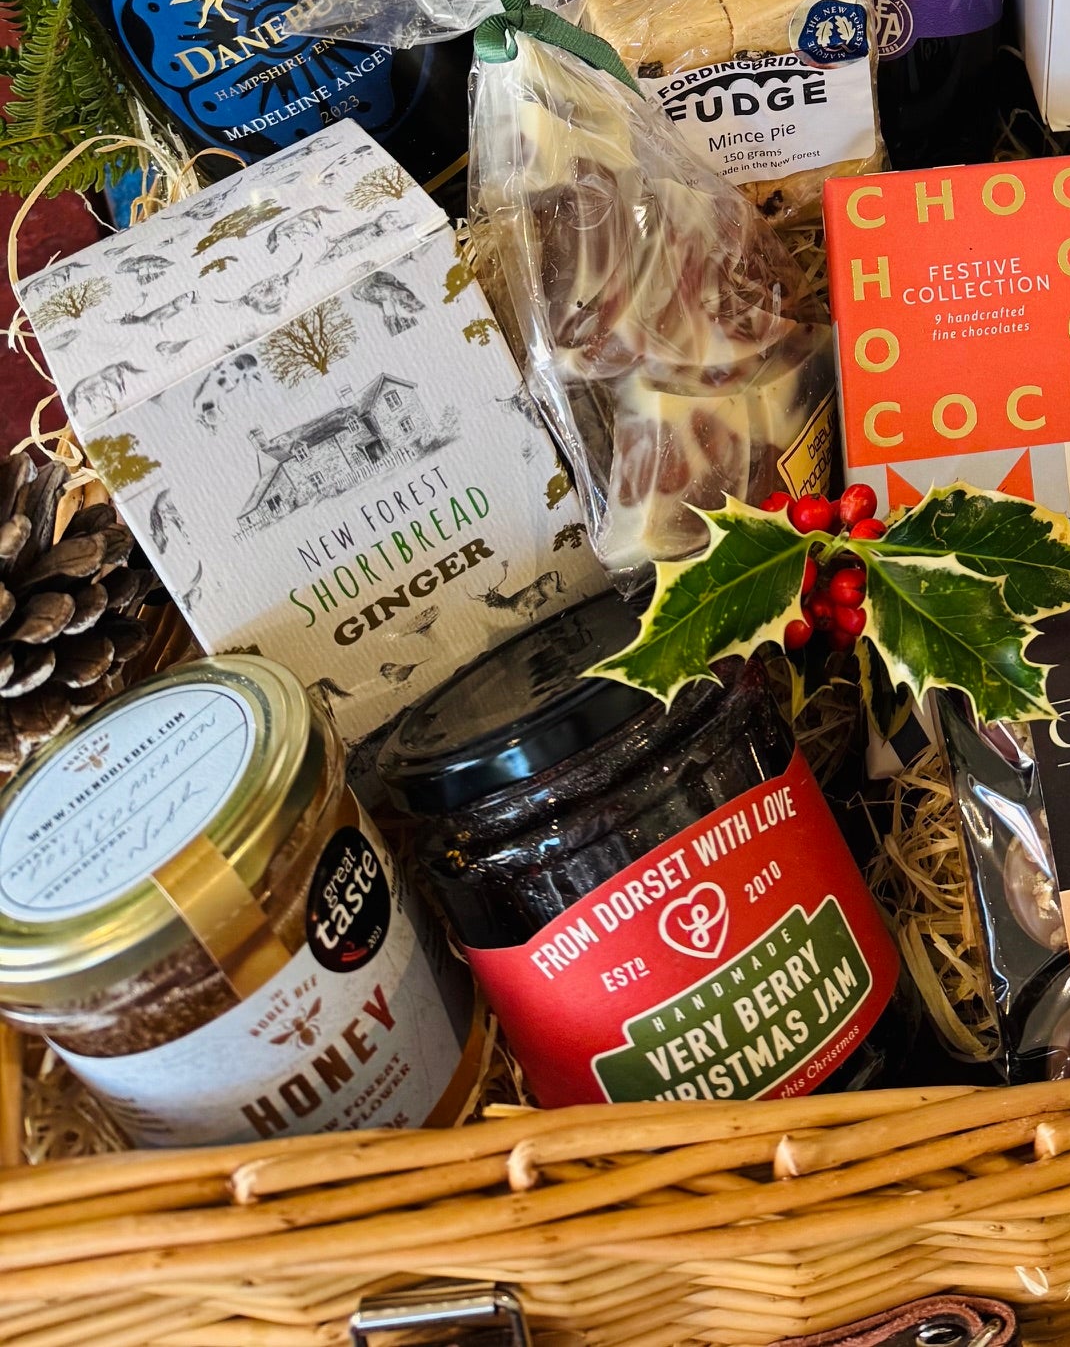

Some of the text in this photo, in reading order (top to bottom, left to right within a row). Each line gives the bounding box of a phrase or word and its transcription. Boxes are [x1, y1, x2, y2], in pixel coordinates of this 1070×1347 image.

[806, 5, 864, 50] THE NEW FOREST
[214, 52, 314, 102] HAMPSHIRE,
[664, 78, 828, 125] FUDGE
[223, 85, 333, 141] MADELEINE
[320, 95, 360, 124] 2023
[708, 123, 796, 152] Mince Pie
[723, 147, 782, 164] 150 grams
[752, 149, 820, 170] the New Forest
[902, 274, 1050, 305] COLLECTION
[928, 257, 1022, 282] FESTIVE
[931, 319, 1031, 343] fine chocolates
[946, 304, 1026, 325] handcrafted
[297, 465, 449, 573] NEW FOREST
[289, 486, 490, 629] SHORTBREAD
[333, 537, 495, 647] GINGER
[316, 850, 378, 950] taste
[323, 847, 357, 909] great
[530, 785, 797, 980] FROM DORSET WITH LOVE
[743, 859, 784, 904] 2010
[652, 927, 794, 1033] HANDMADE
[817, 956, 858, 1026] JAM
[645, 938, 823, 1082] VERY BERRY
[240, 983, 397, 1140] HONEY
[805, 1024, 860, 1080] Christmas
